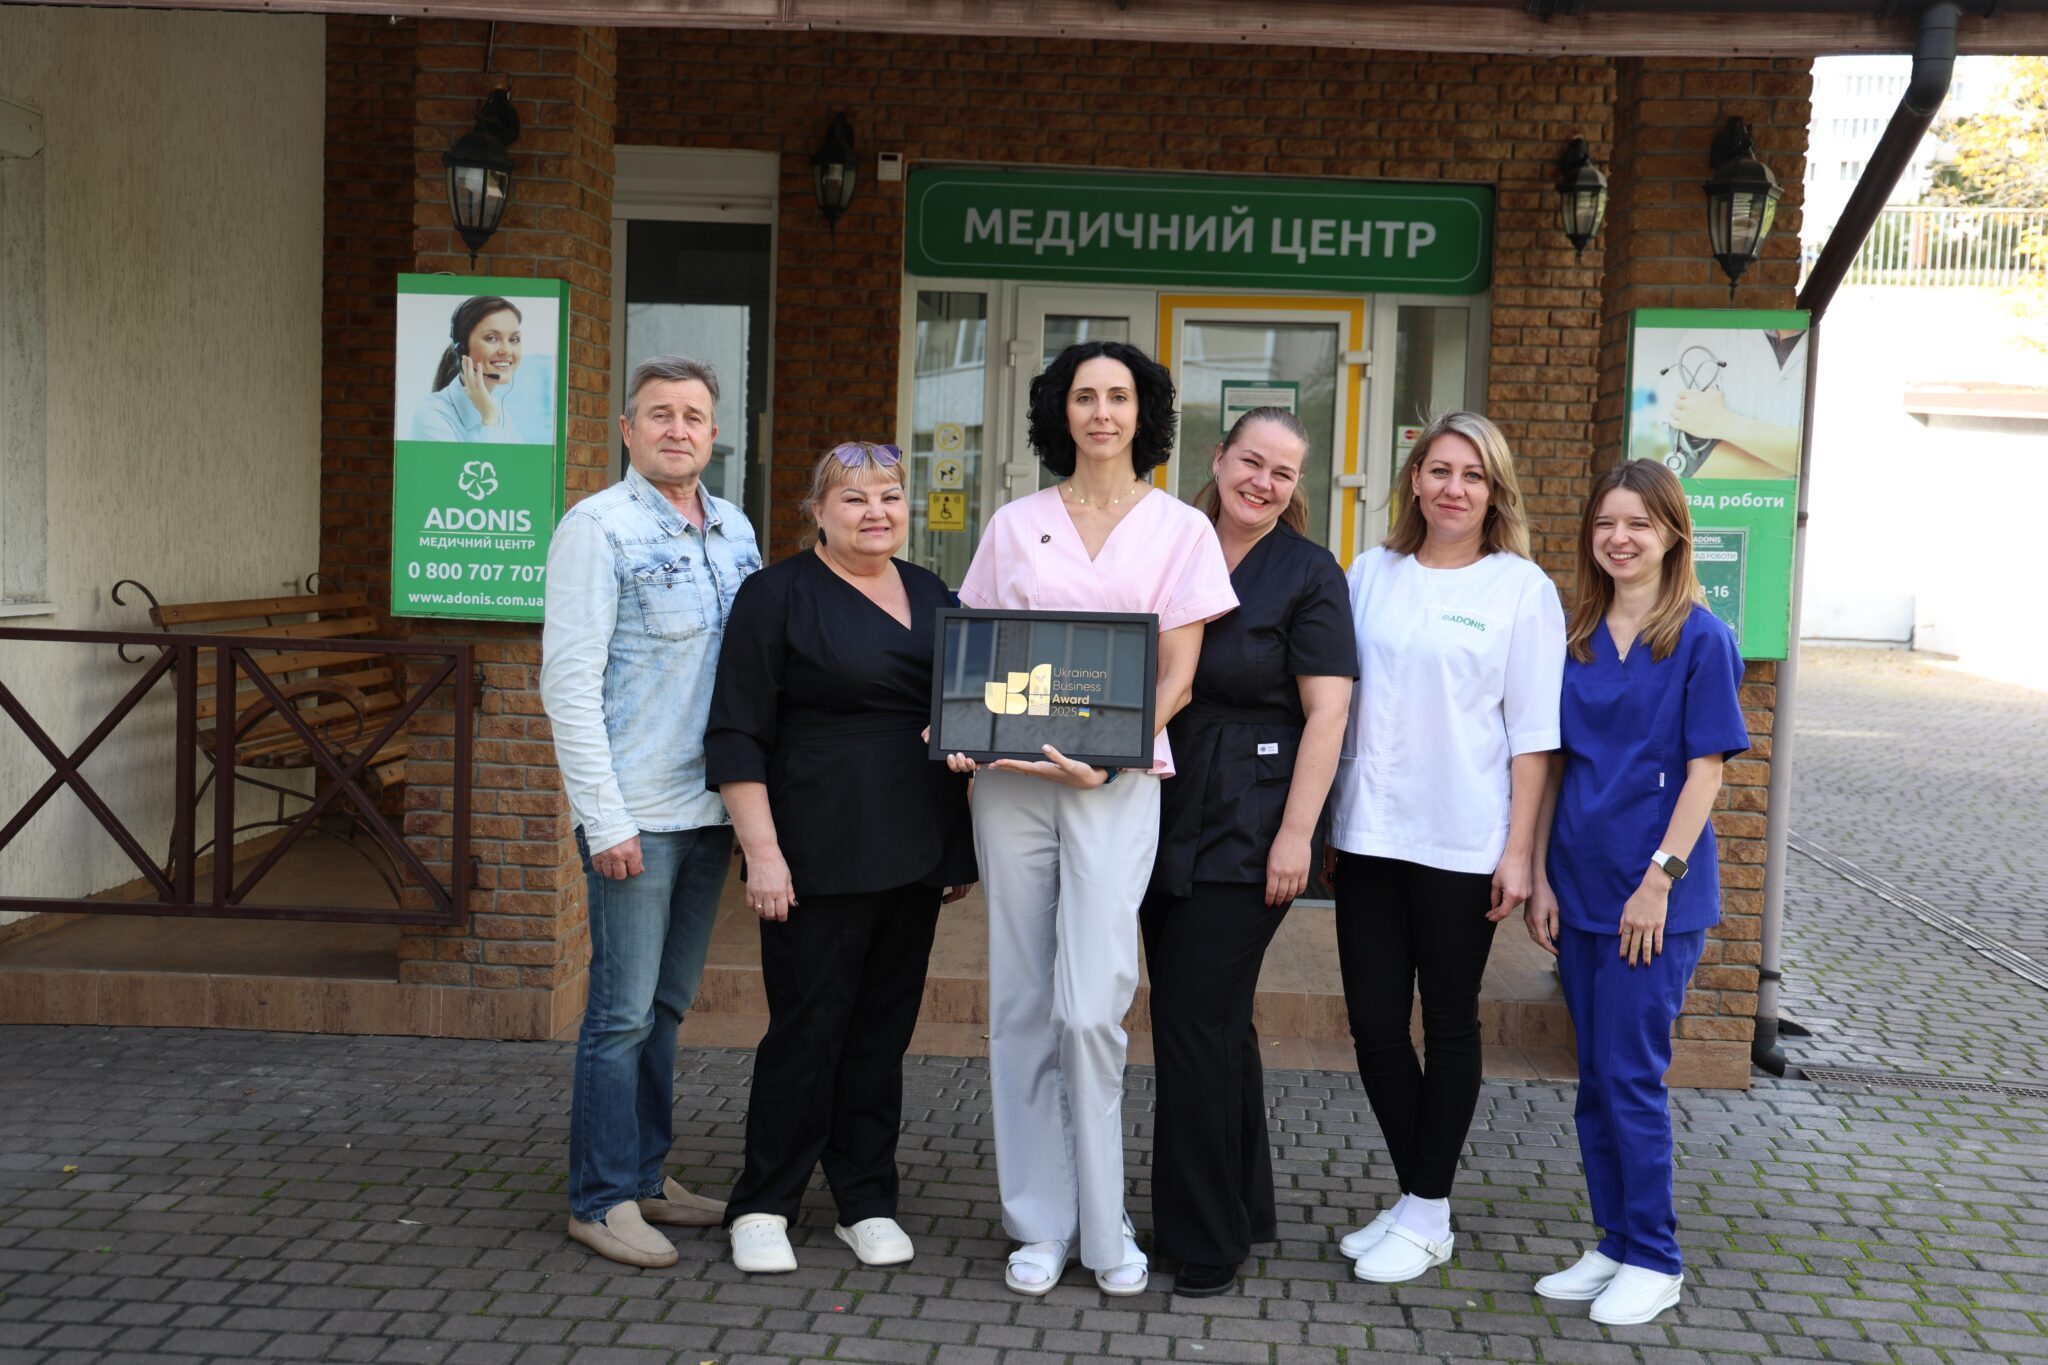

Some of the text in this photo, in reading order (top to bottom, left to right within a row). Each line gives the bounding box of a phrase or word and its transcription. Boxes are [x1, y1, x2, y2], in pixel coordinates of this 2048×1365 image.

[963, 205, 1437, 265] МЕДИЧНИЙ ЦЕНТР
[1719, 492, 1785, 510] роботи
[424, 507, 532, 532] ADONIS
[419, 536, 536, 551] МЕДИЧНИЙ ЦЕНТР
[408, 561, 545, 583] 0 800 707 707
[408, 592, 544, 607] www.adonis.com.ua
[1449, 615, 1486, 632] ADONIS
[1053, 667, 1107, 679] Ukrainian
[1053, 680, 1102, 692] Business
[1052, 693, 1090, 705] Award
[1051, 706, 1077, 717] 2025
